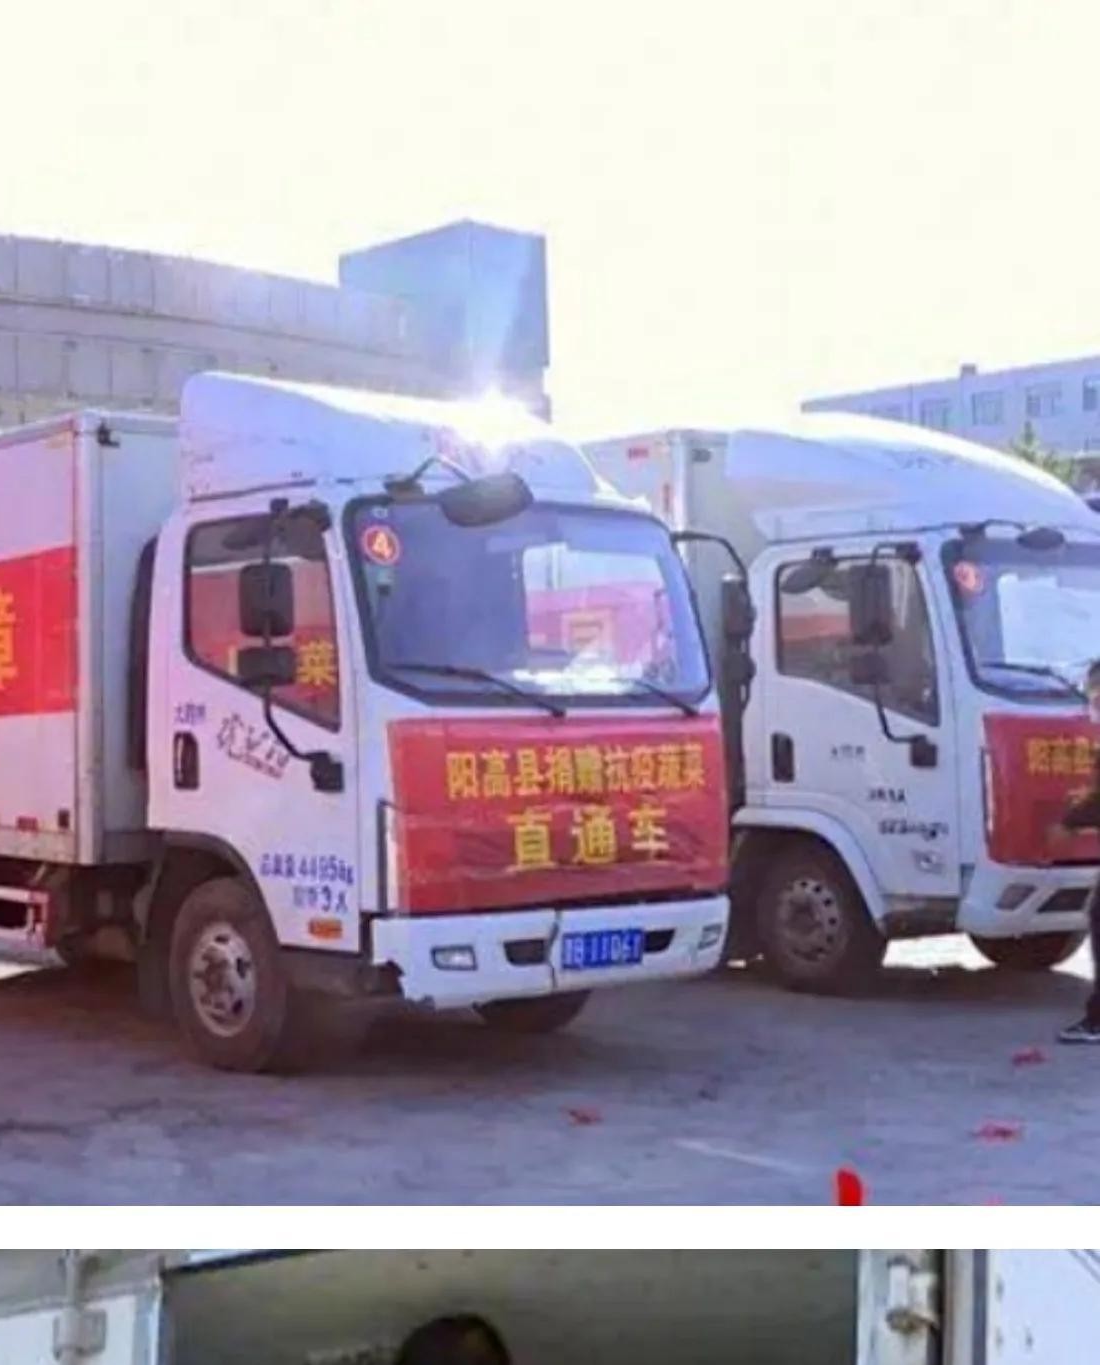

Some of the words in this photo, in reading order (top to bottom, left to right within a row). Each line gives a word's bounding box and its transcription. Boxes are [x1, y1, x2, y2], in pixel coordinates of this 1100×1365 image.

[446, 743, 706, 799] 阳高县捐赠抗疫蔬菜
[505, 800, 670, 874] 直通车
